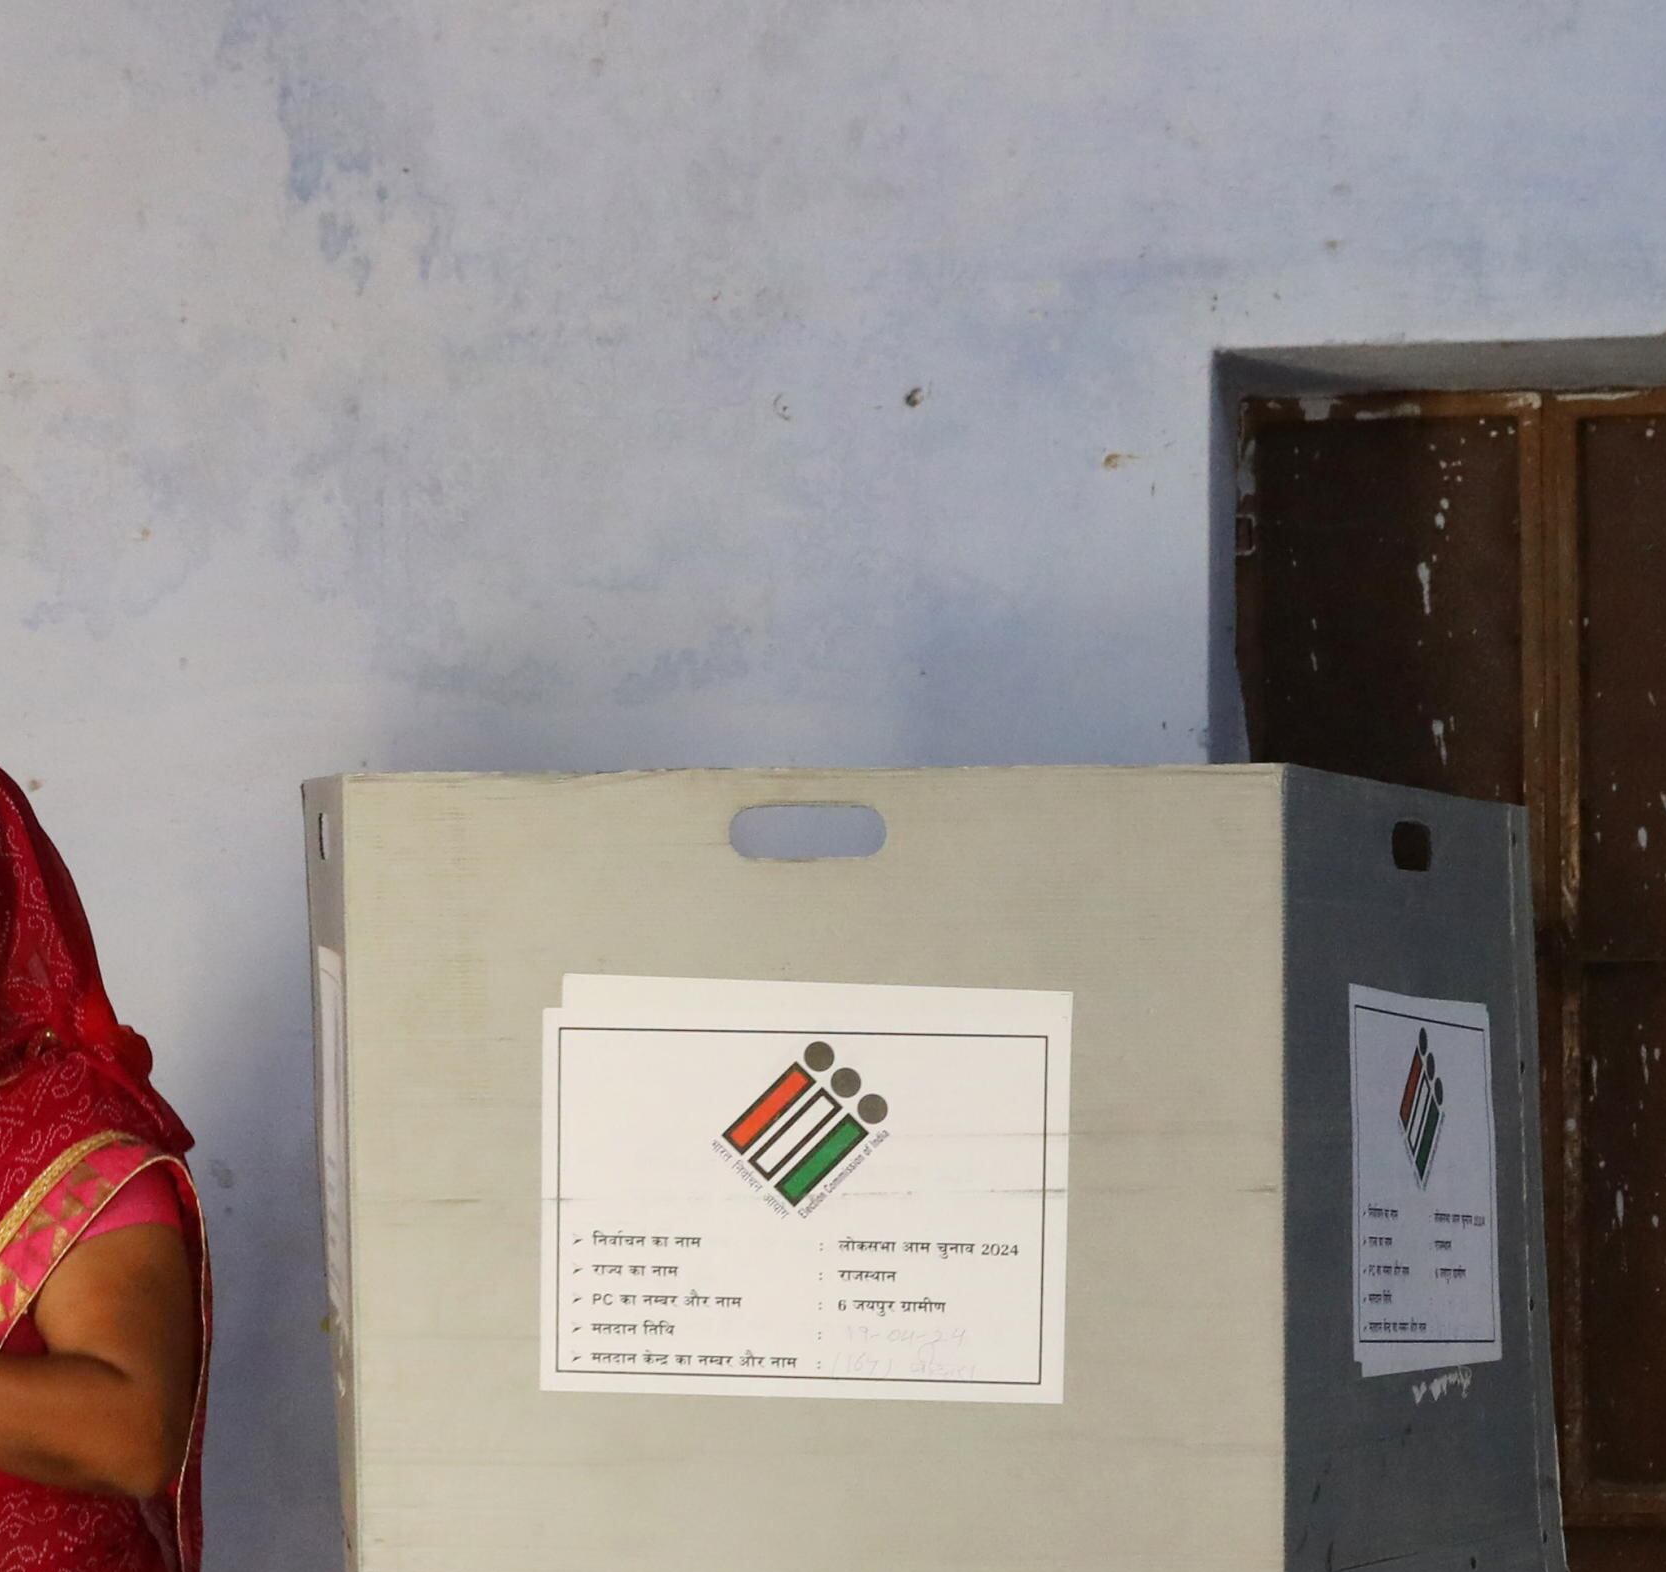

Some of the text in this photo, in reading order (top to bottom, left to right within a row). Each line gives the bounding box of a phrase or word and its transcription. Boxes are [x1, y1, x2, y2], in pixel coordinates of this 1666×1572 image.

[711, 1139, 790, 1220] भारत निर्वाचन आयोग
[797, 1128, 891, 1220] Election Commission of India
[592, 1229, 646, 1247] निर्वाचन
[651, 1236, 669, 1248] का
[674, 1236, 702, 1248] नाम
[837, 1235, 896, 1253] लोकसभा
[902, 1241, 931, 1254] आम
[936, 1241, 975, 1260] चुनाव
[981, 1243, 1020, 1257] 2024
[591, 1264, 623, 1277] राज्य
[628, 1264, 646, 1277] का
[651, 1265, 679, 1278] नाम
[837, 1269, 897, 1283] राजस्थान
[591, 1293, 614, 1306] PC
[619, 1293, 637, 1306] का
[642, 1294, 678, 1307] नम्बर
[684, 1288, 710, 1308] और
[714, 1295, 742, 1308] नाम
[838, 1299, 847, 1312] 6
[852, 1299, 895, 1317] जयपुर
[900, 1297, 947, 1314] ग्रामीण
[591, 1322, 638, 1336] मतदान
[642, 1319, 676, 1336] तिथि
[590, 1352, 637, 1365] मतदान
[642, 1348, 669, 1366] केन्द्र
[675, 1353, 692, 1366] का
[697, 1354, 733, 1367] नम्बर
[739, 1349, 765, 1368] और
[770, 1355, 797, 1368] नाम
